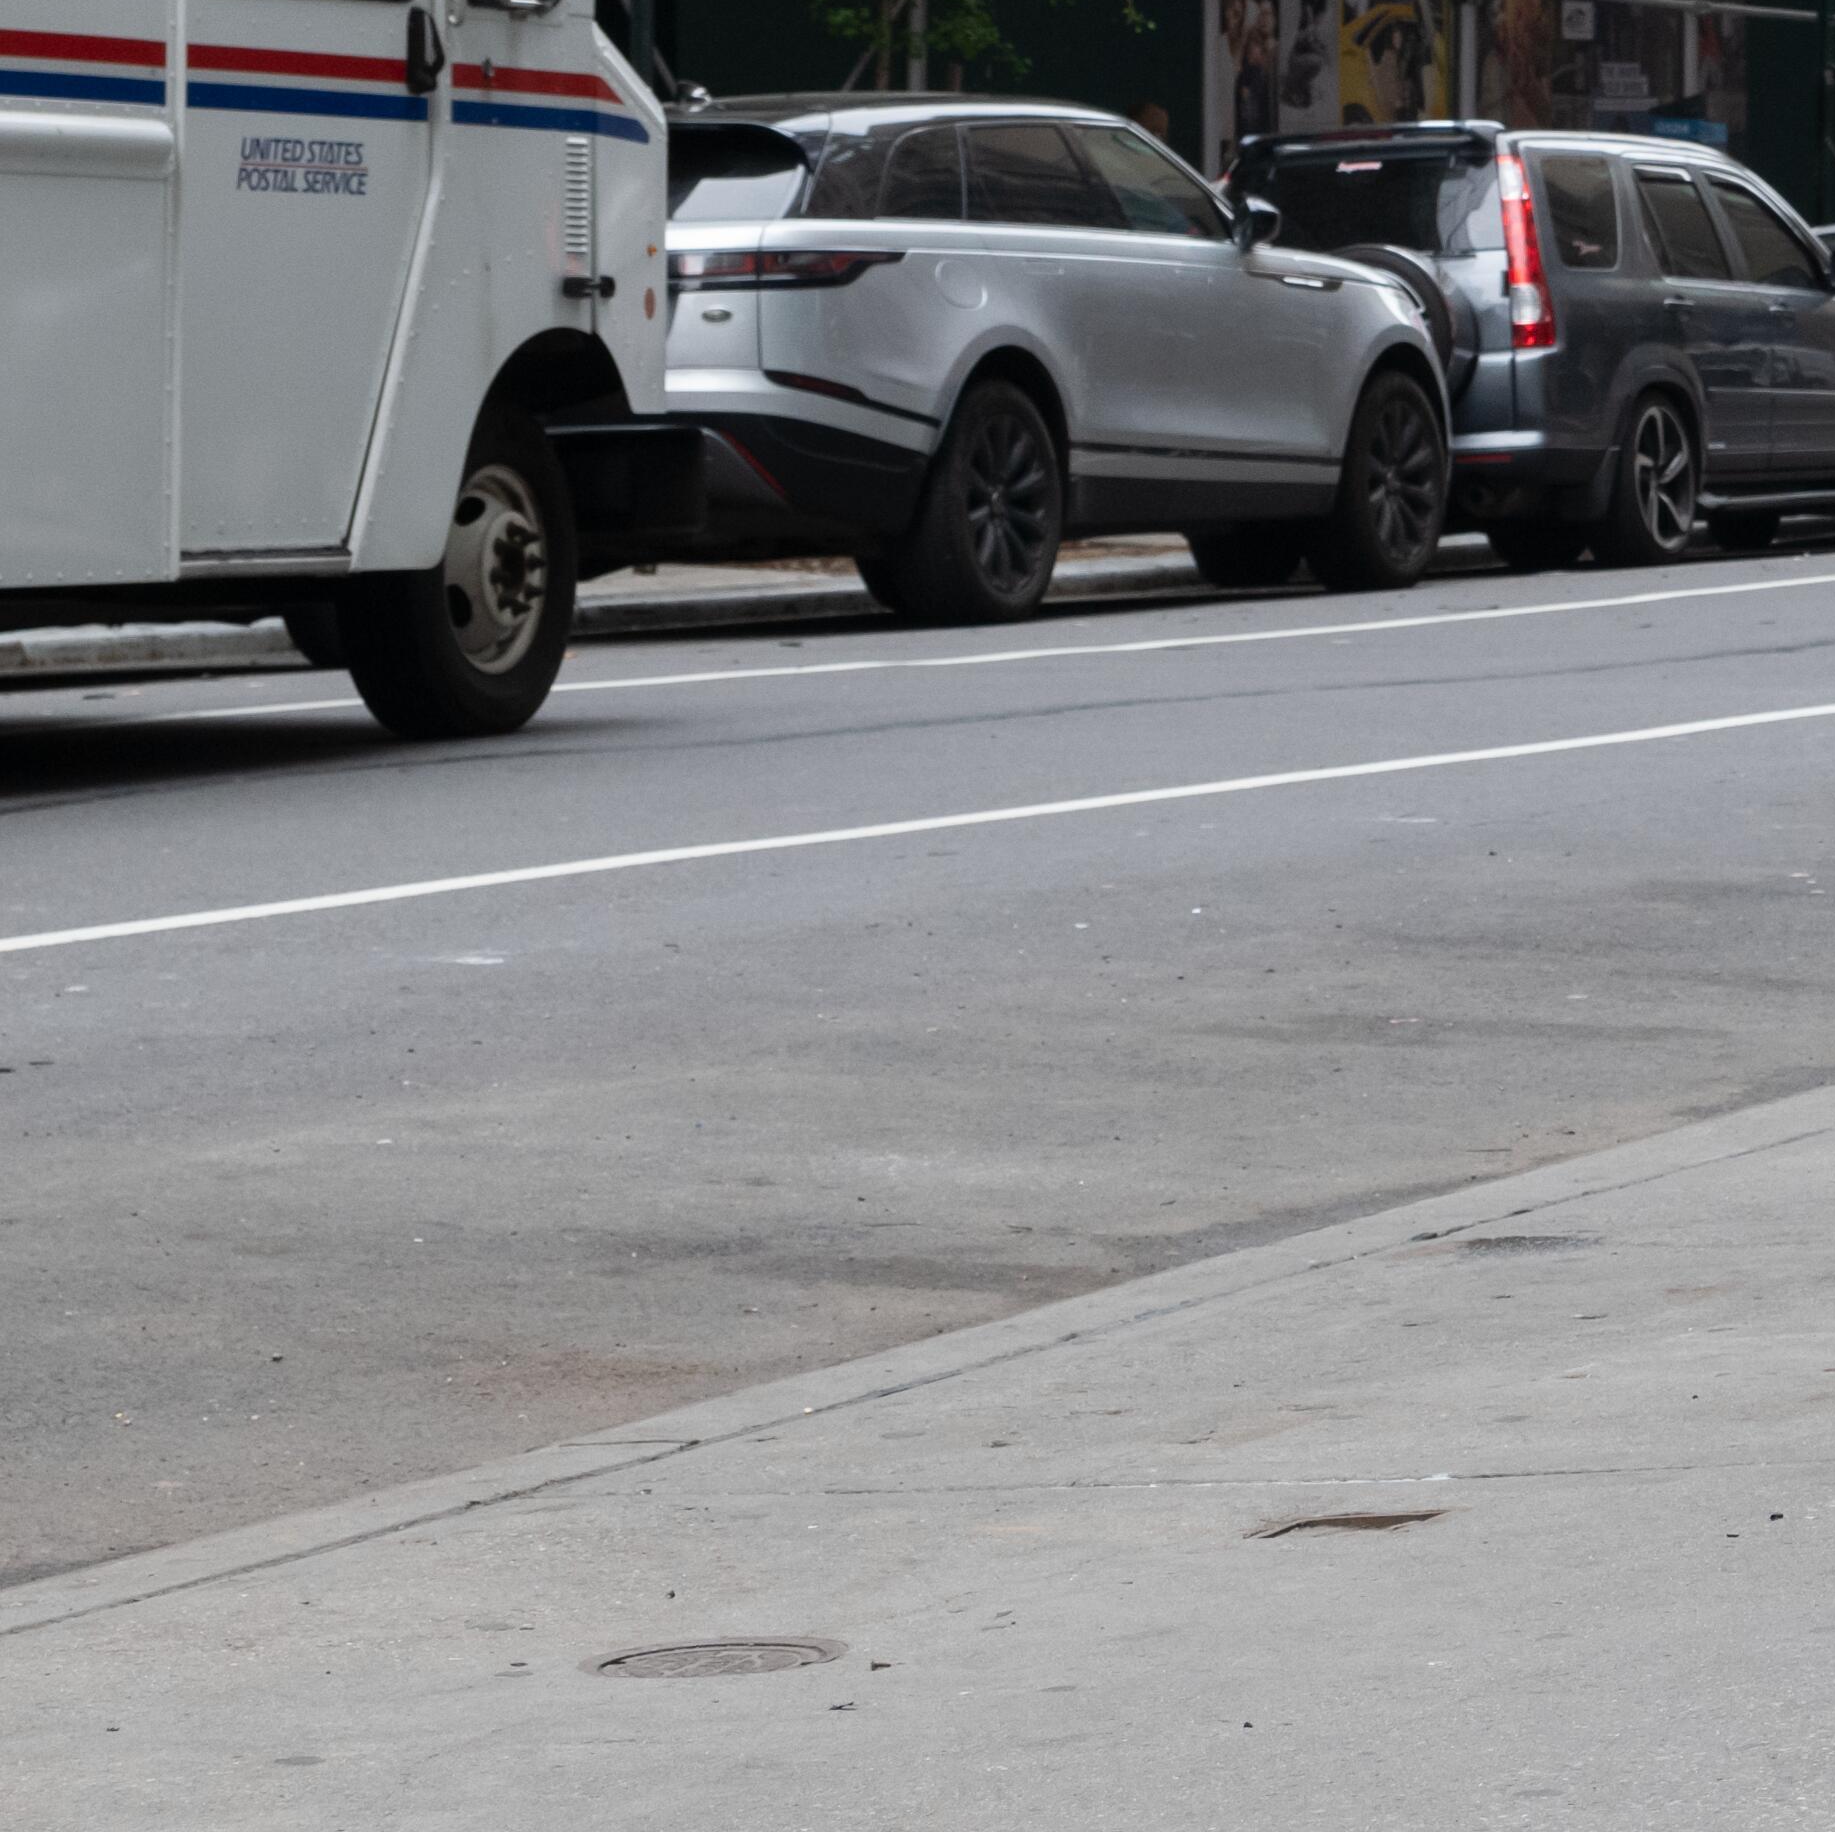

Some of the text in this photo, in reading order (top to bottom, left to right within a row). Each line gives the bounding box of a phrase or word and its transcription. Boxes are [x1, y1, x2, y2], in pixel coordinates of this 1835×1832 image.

[240, 137, 365, 166] UNITED STATES
[236, 168, 369, 196] POSTAL SERVICE
